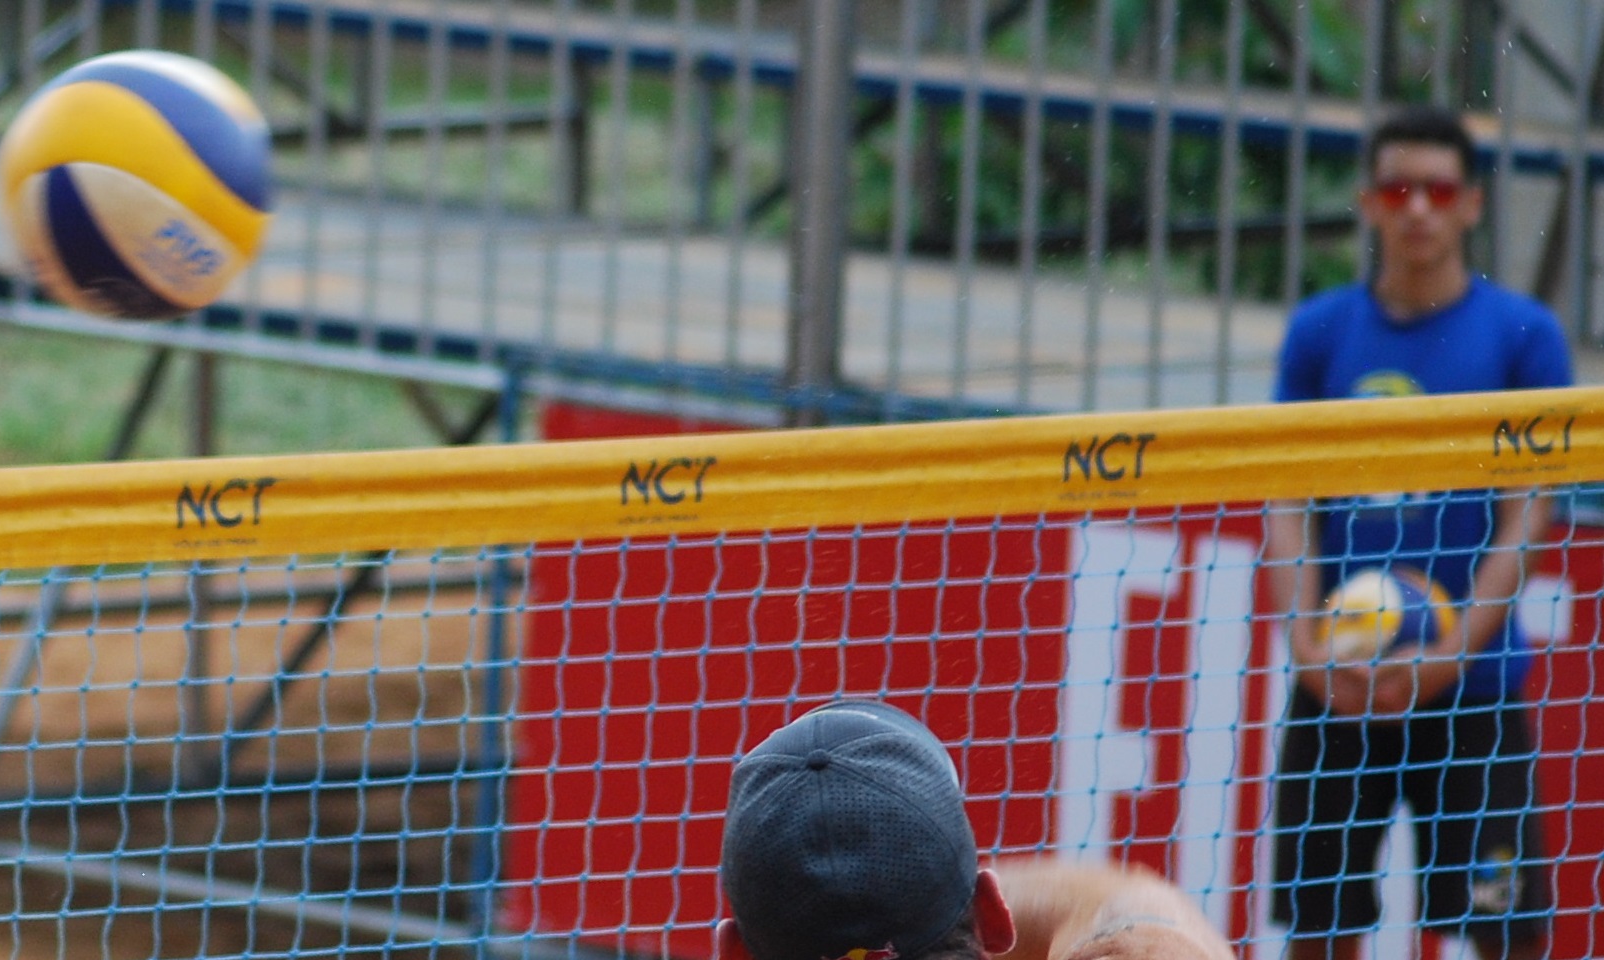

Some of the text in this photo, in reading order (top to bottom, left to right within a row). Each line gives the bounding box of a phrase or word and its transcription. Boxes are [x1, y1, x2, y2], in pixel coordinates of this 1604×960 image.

[1493, 407, 1578, 456] NCT
[621, 456, 717, 505] NCT
[1062, 432, 1155, 482] NCT
[176, 477, 278, 528] NCT
